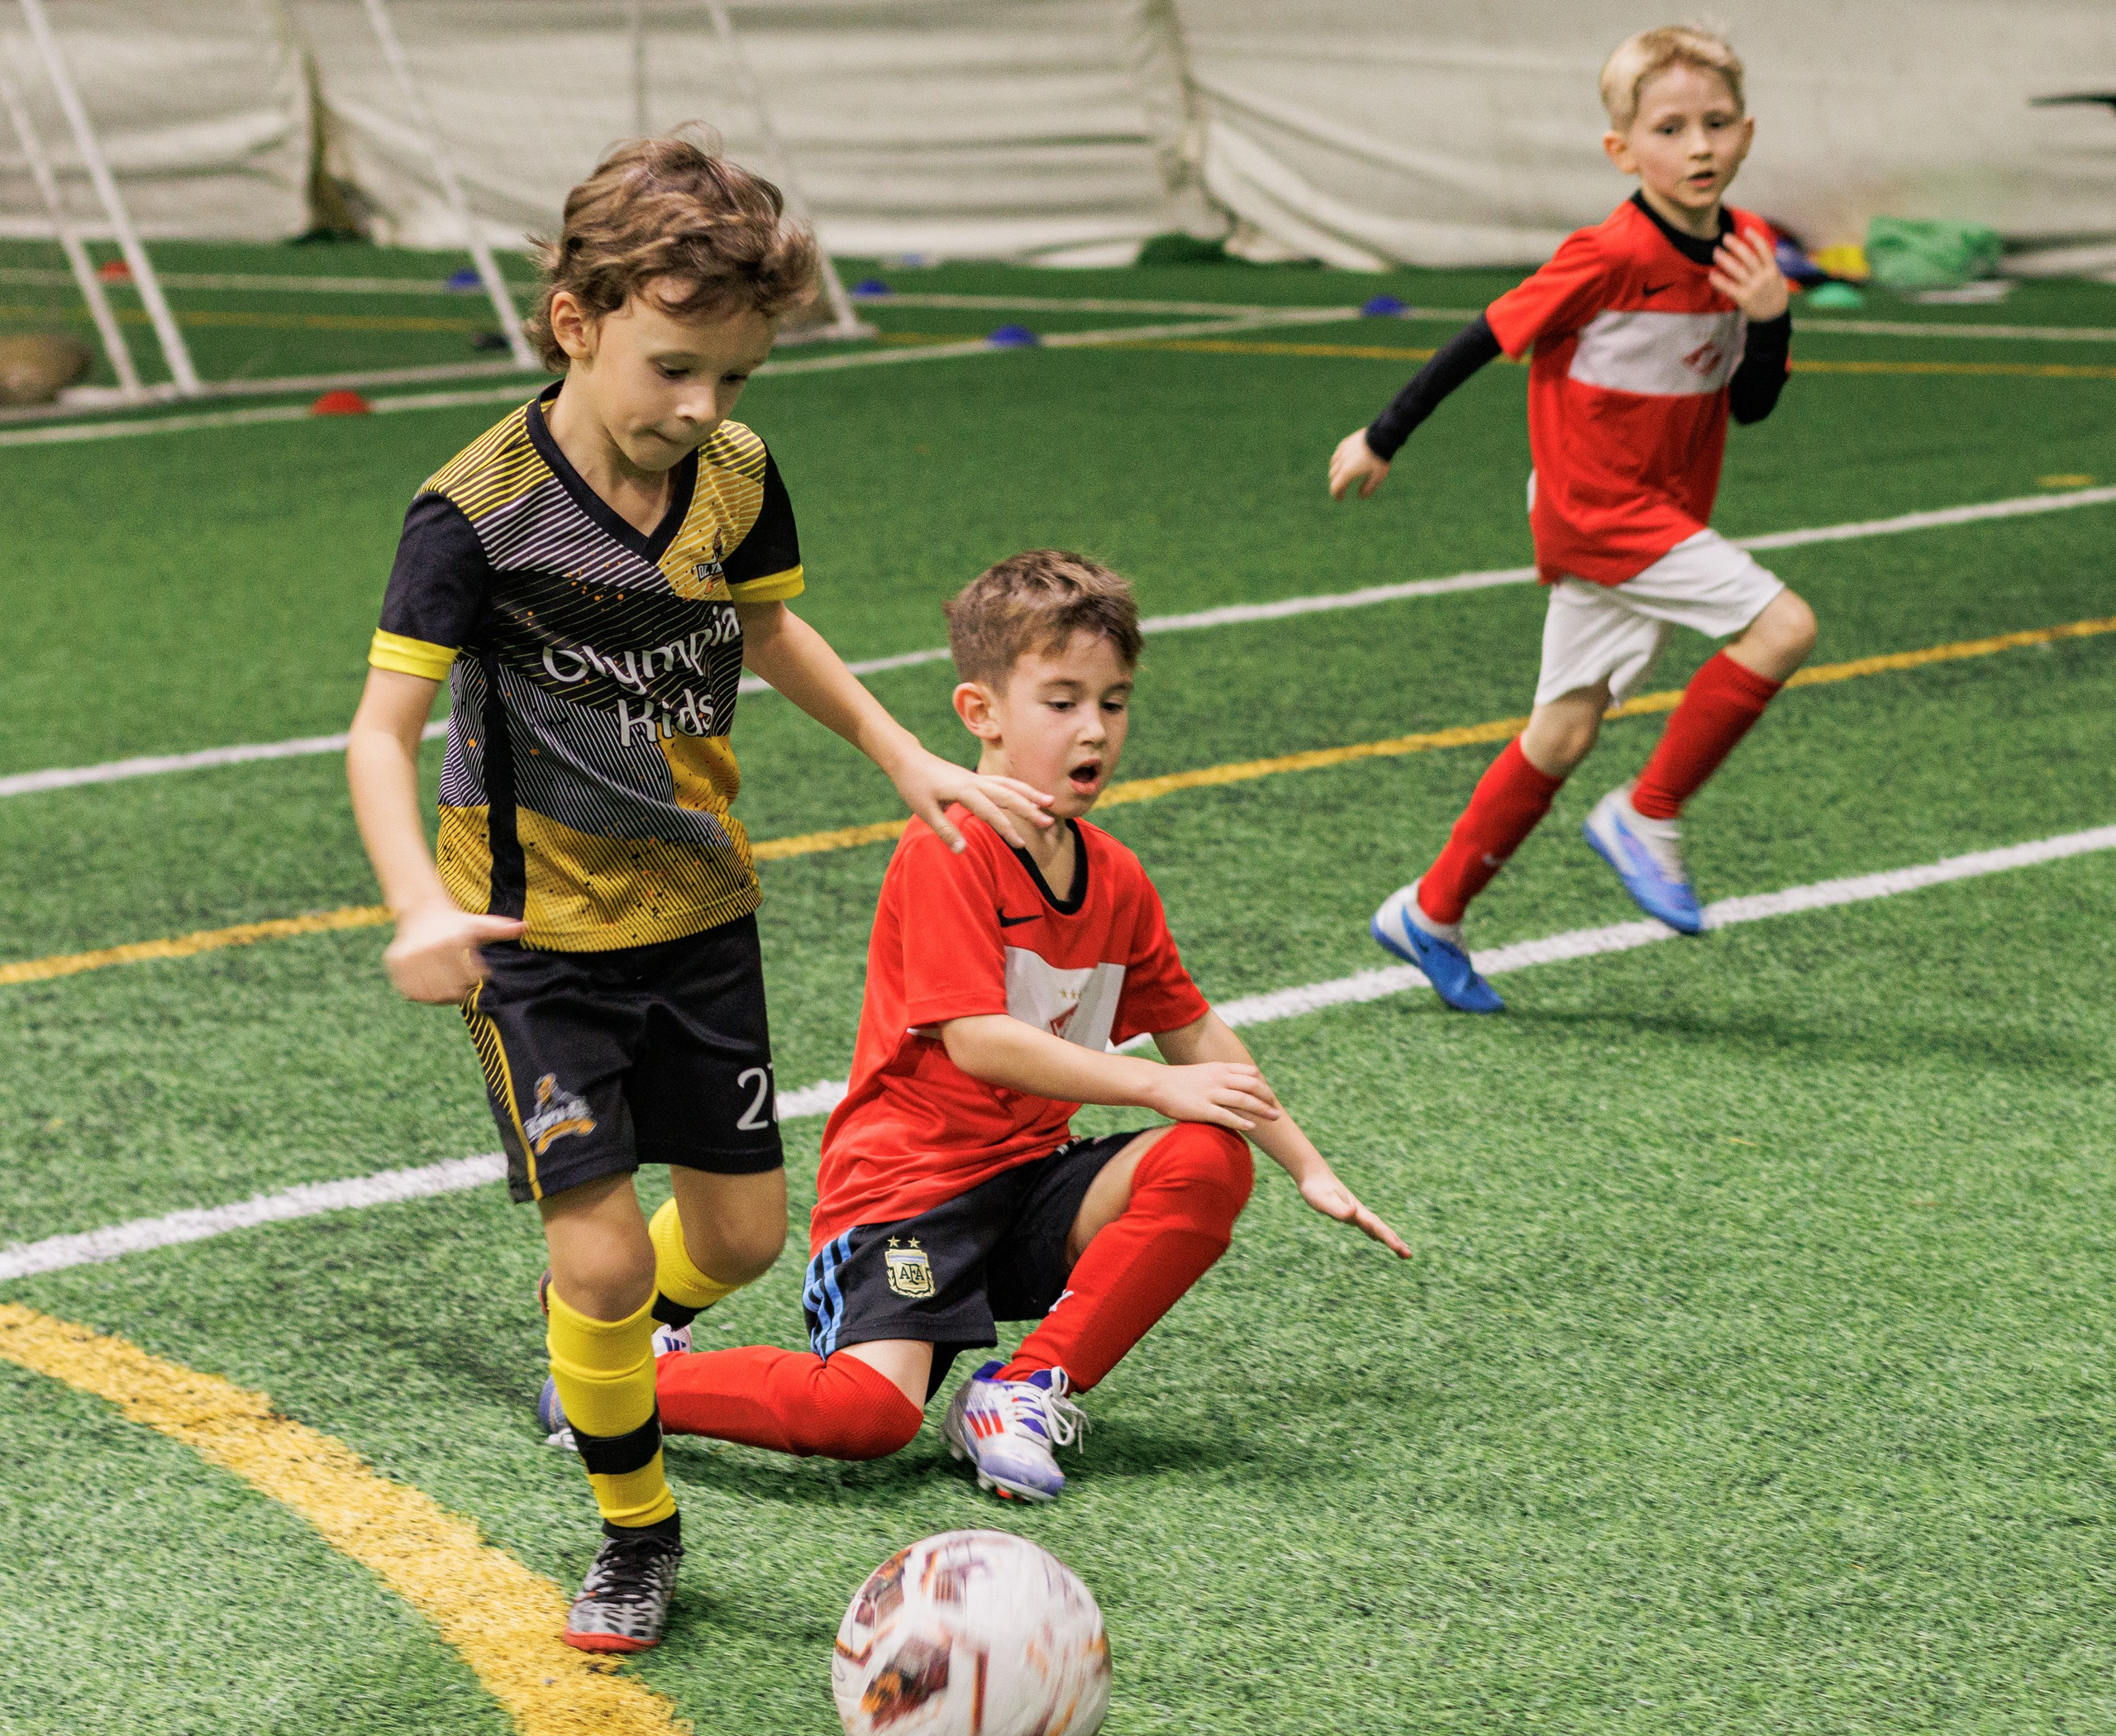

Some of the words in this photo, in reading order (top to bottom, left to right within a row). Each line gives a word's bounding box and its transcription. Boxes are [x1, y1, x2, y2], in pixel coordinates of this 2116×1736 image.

[542, 605, 741, 695] Olympia
[617, 689, 714, 747] Kids
[899, 1262, 925, 1285] AFA
